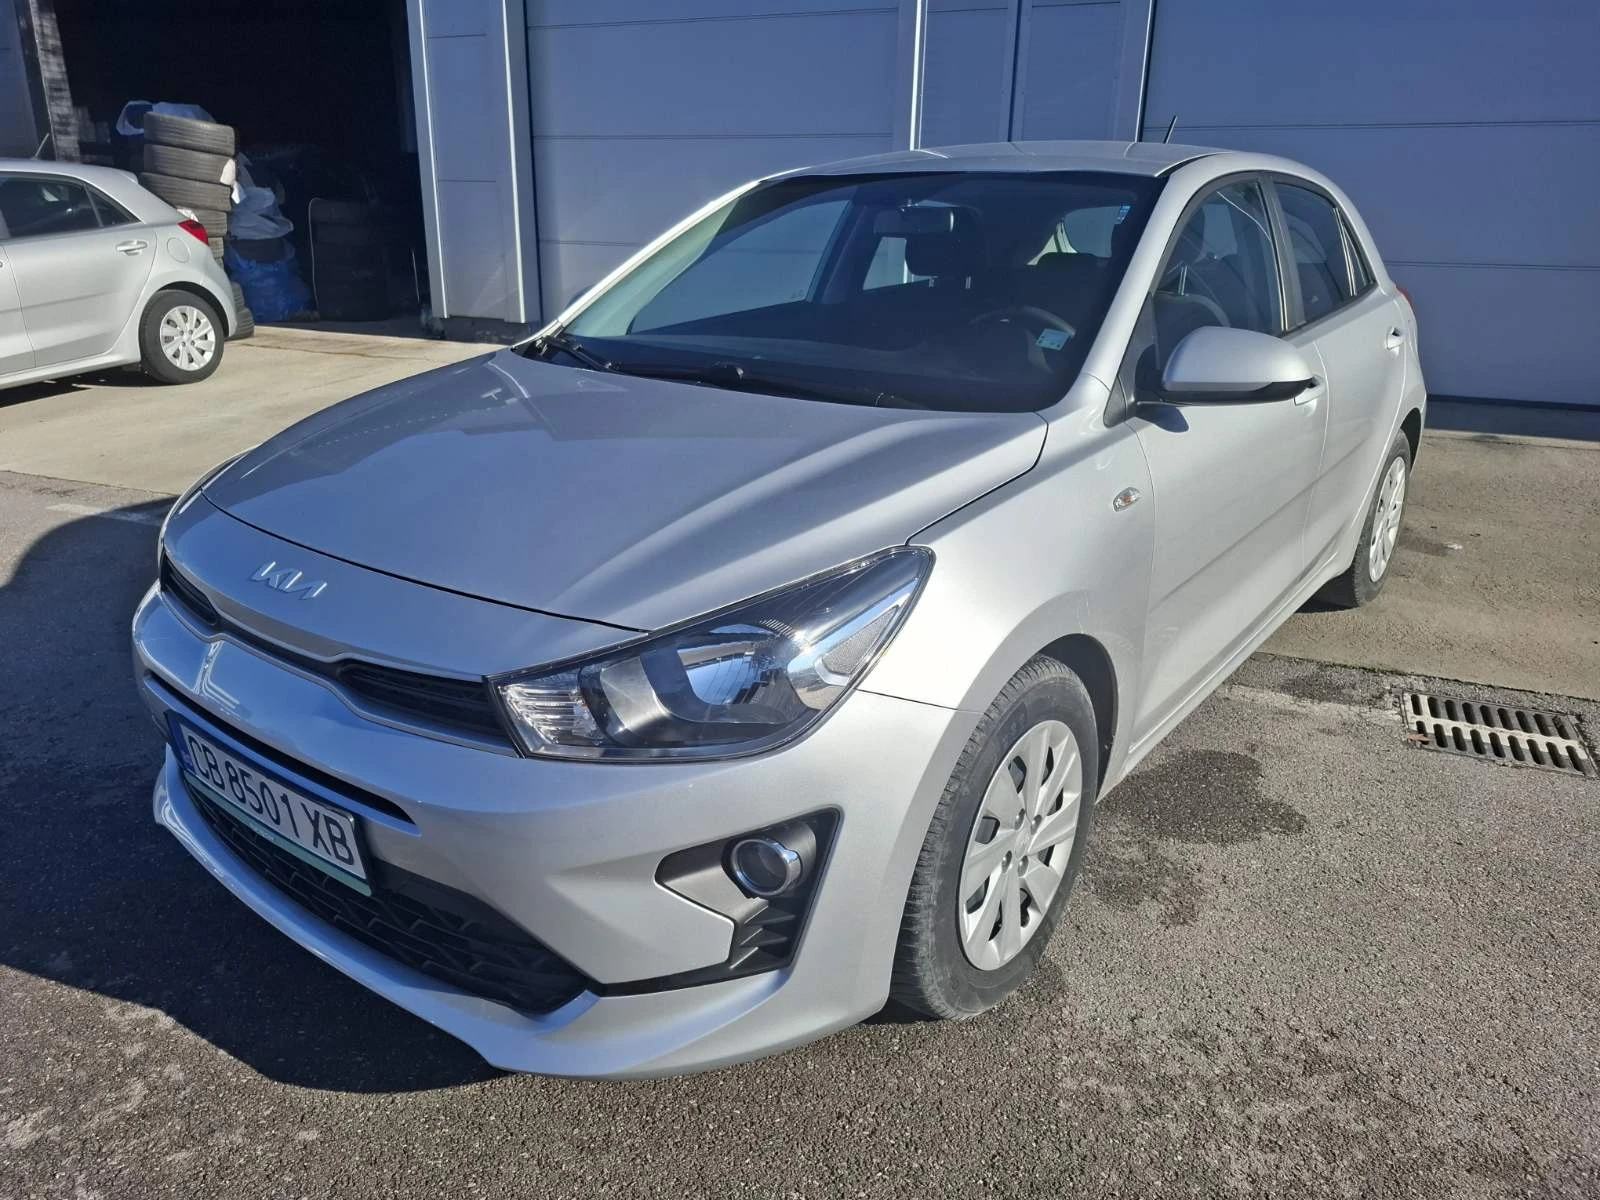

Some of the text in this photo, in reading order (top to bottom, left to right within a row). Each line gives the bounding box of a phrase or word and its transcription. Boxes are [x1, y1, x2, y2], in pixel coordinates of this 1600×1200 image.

[188, 735, 354, 866] CB 8501 XB
